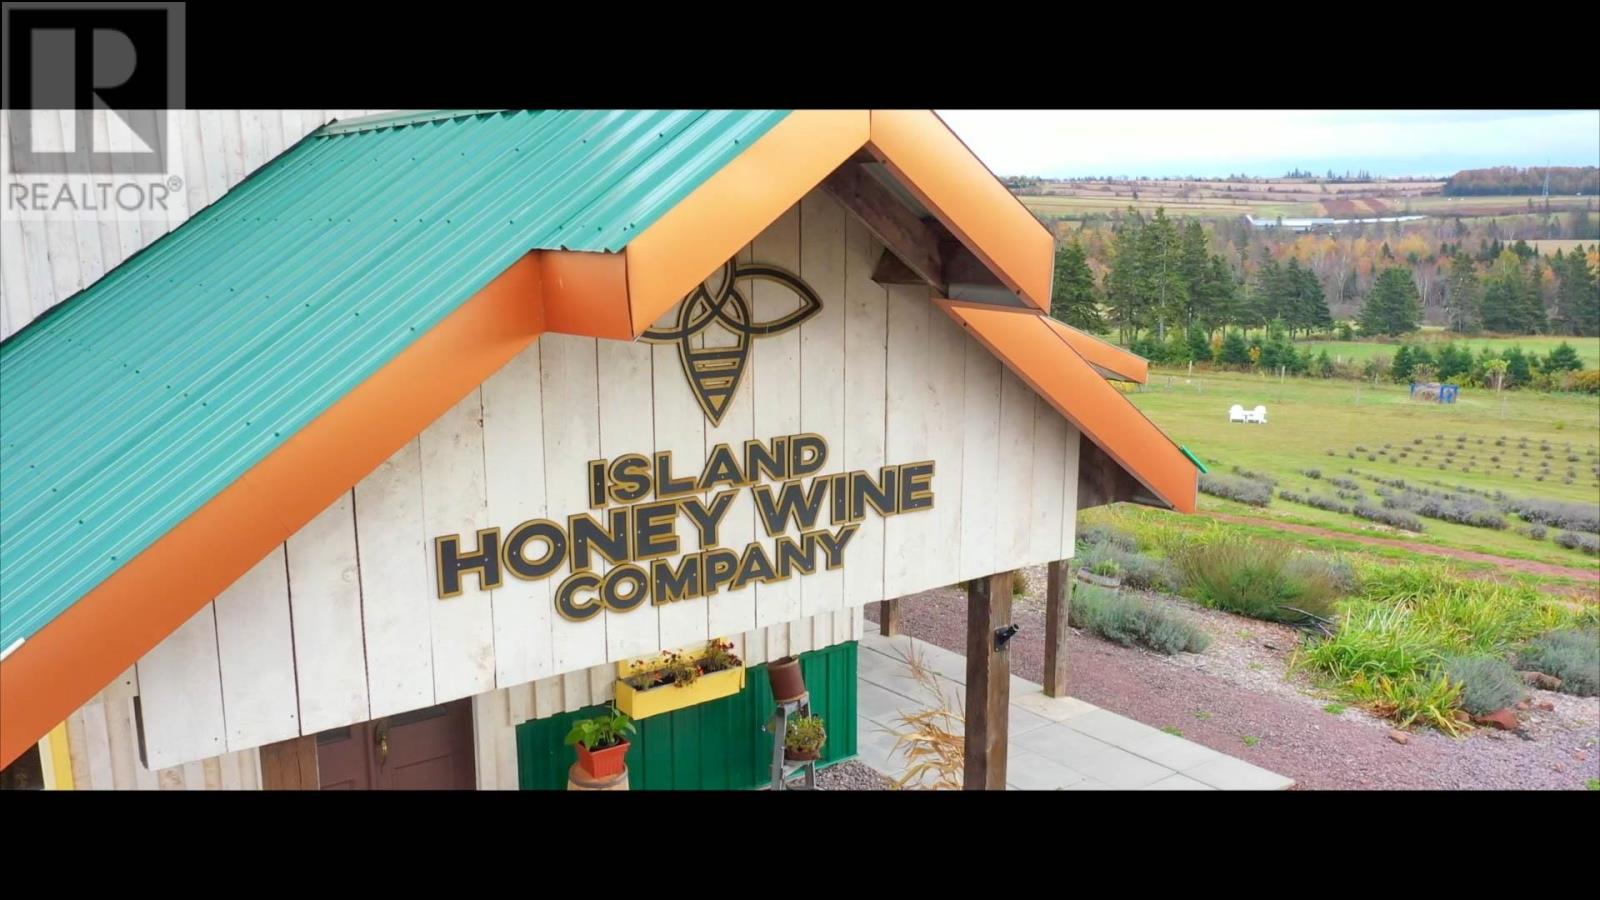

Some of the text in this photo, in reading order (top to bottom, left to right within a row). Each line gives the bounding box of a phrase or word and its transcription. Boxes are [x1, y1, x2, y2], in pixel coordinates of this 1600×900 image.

[588, 432, 829, 509] ISLAND
[435, 460, 935, 599] HONEY WINE
[555, 523, 861, 622] COMPANY
